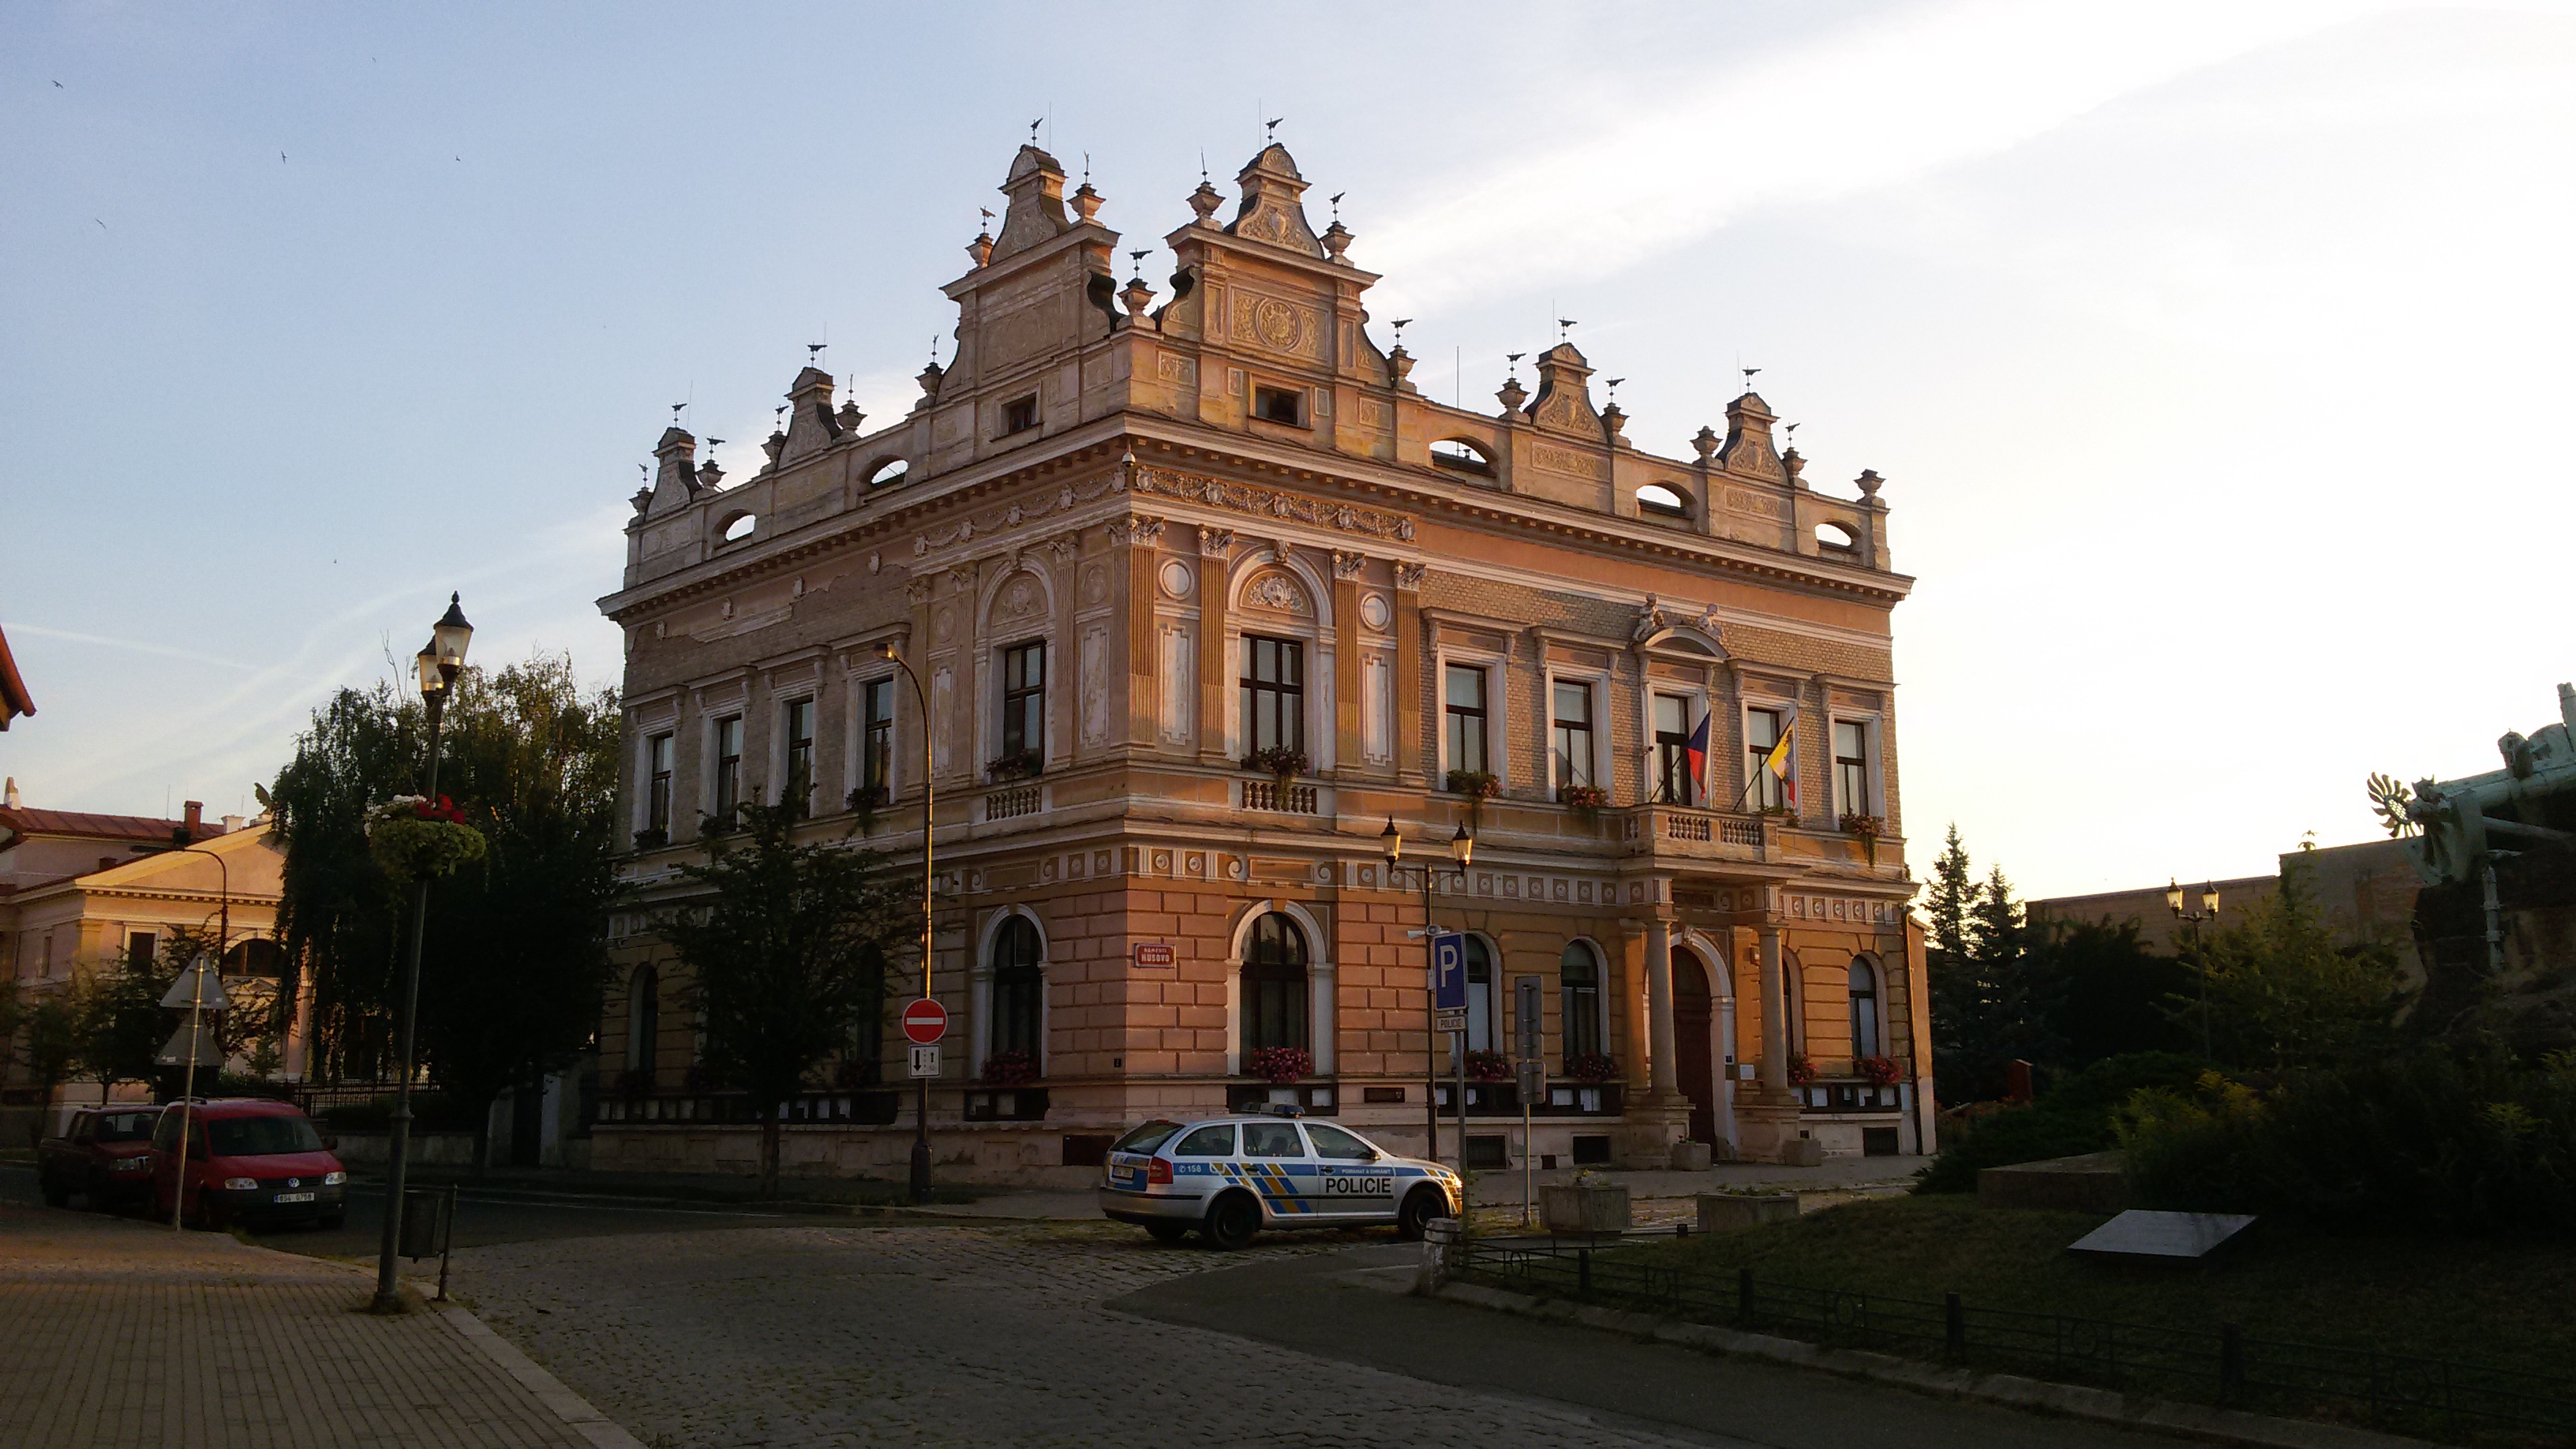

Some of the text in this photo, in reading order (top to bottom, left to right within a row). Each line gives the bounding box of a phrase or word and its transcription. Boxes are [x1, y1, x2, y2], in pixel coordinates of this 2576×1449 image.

[1141, 953, 1170, 962] HUSOVO
[1440, 945, 1458, 987] P
[1440, 1017, 1462, 1028] POLICIE
[1187, 1164, 1202, 1173] 158
[1326, 1178, 1391, 1193] POLICIE
